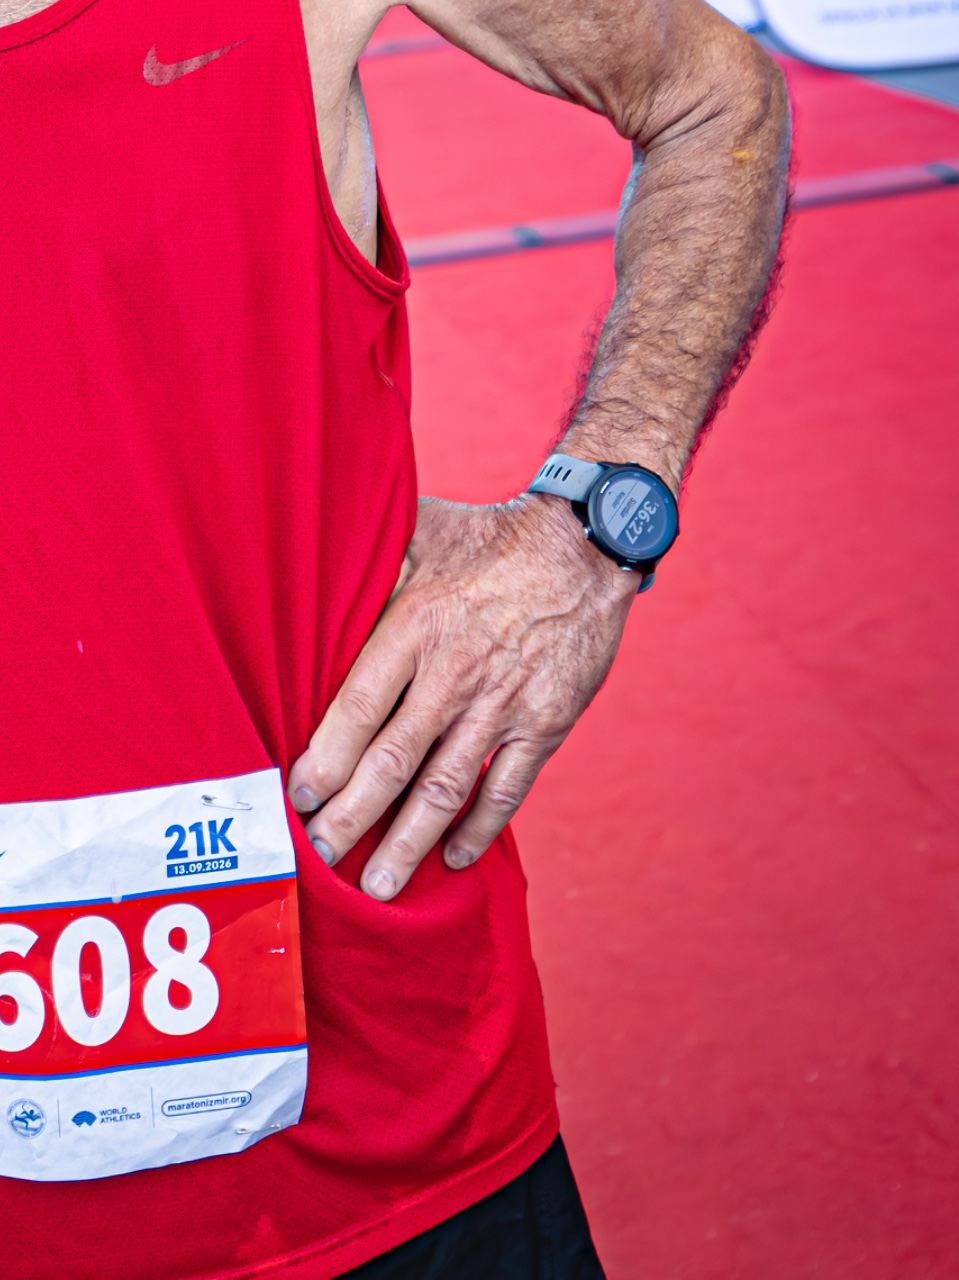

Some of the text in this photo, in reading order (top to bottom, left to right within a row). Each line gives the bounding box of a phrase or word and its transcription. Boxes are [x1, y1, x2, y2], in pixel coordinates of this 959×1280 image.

[624, 500, 657, 545] 36:27
[165, 817, 238, 860] 21K
[173, 859, 232, 875] 13.09.2026
[99, 1107, 128, 1117] WORLD
[167, 1095, 246, 1113] maratonizmir.org
[100, 1112, 141, 1125] ATHLETICS
